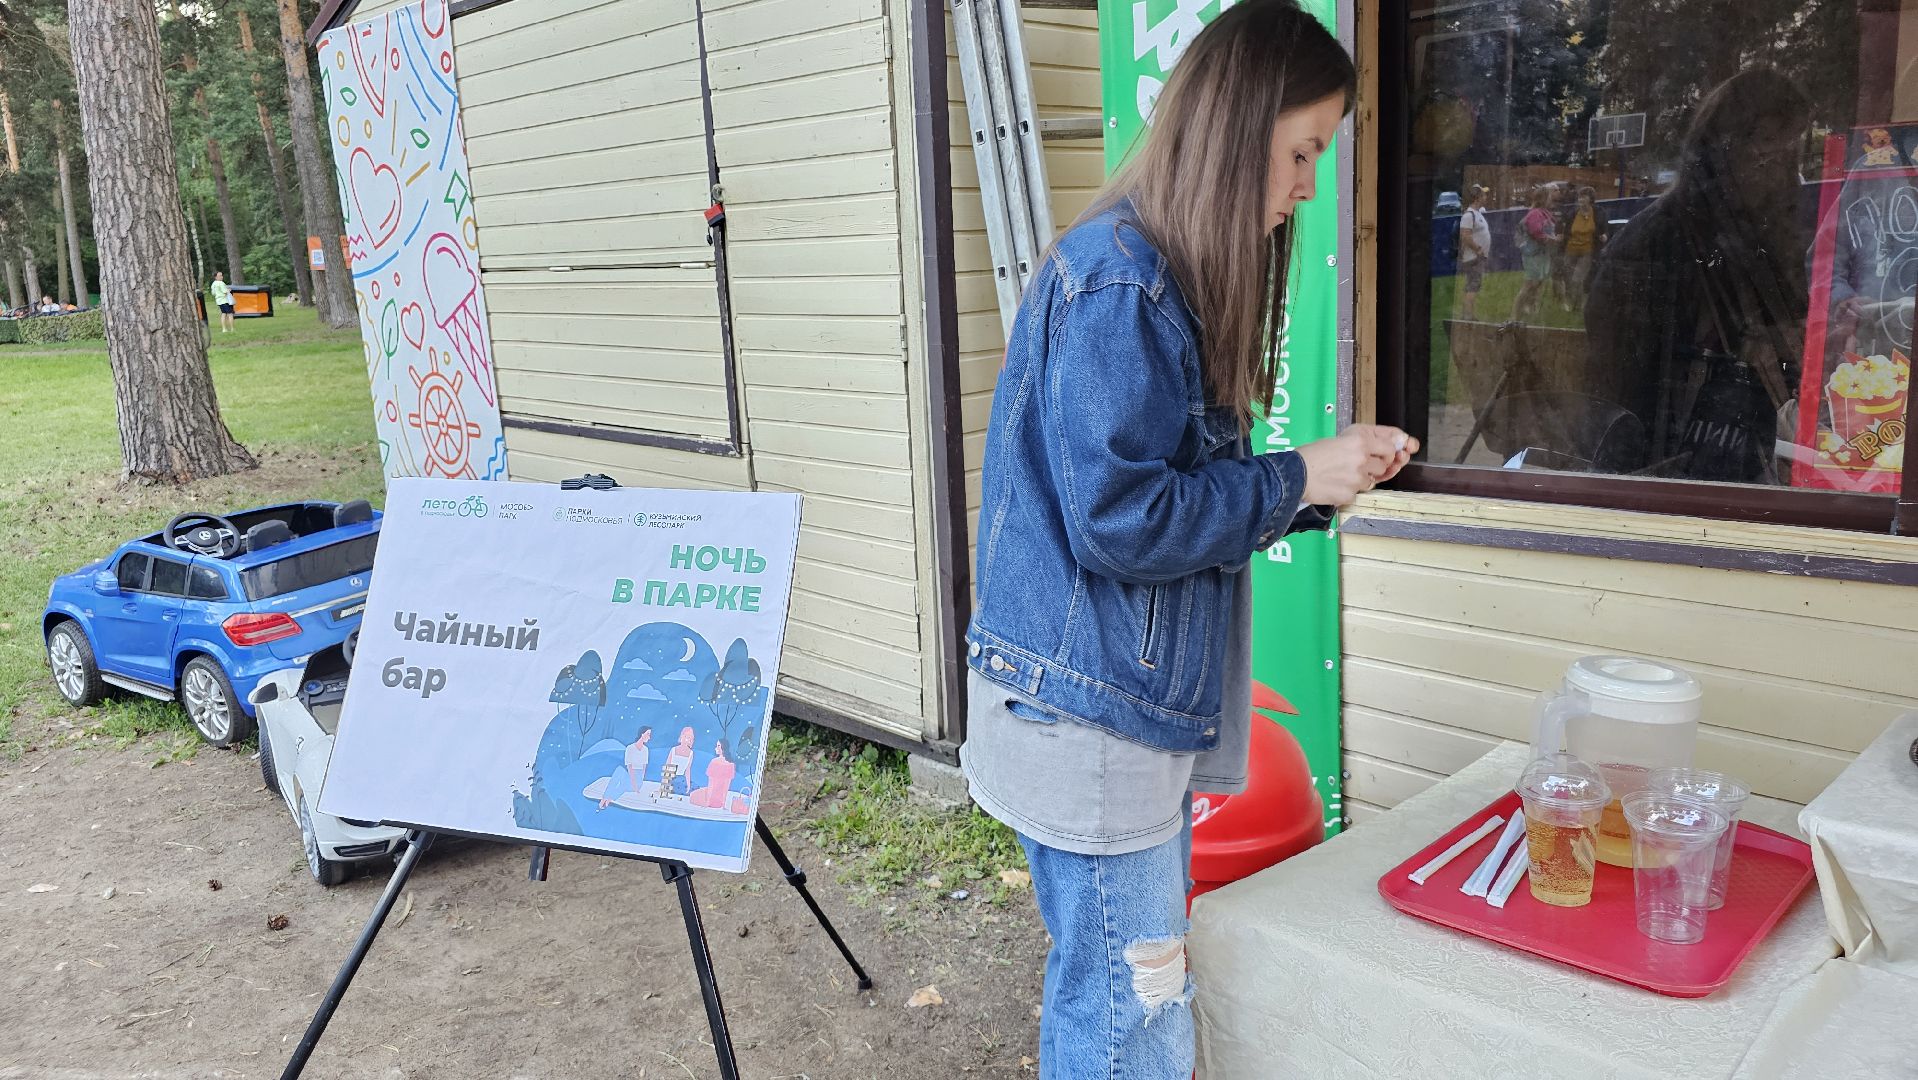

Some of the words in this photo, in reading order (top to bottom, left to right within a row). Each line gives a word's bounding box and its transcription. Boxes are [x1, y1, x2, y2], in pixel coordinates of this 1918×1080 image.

[669, 544, 767, 574] НОЧЬ
[611, 578, 635, 603] В
[643, 580, 762, 613] ПАРКЕ
[393, 611, 540, 651] Чайный
[381, 656, 447, 699] бар
